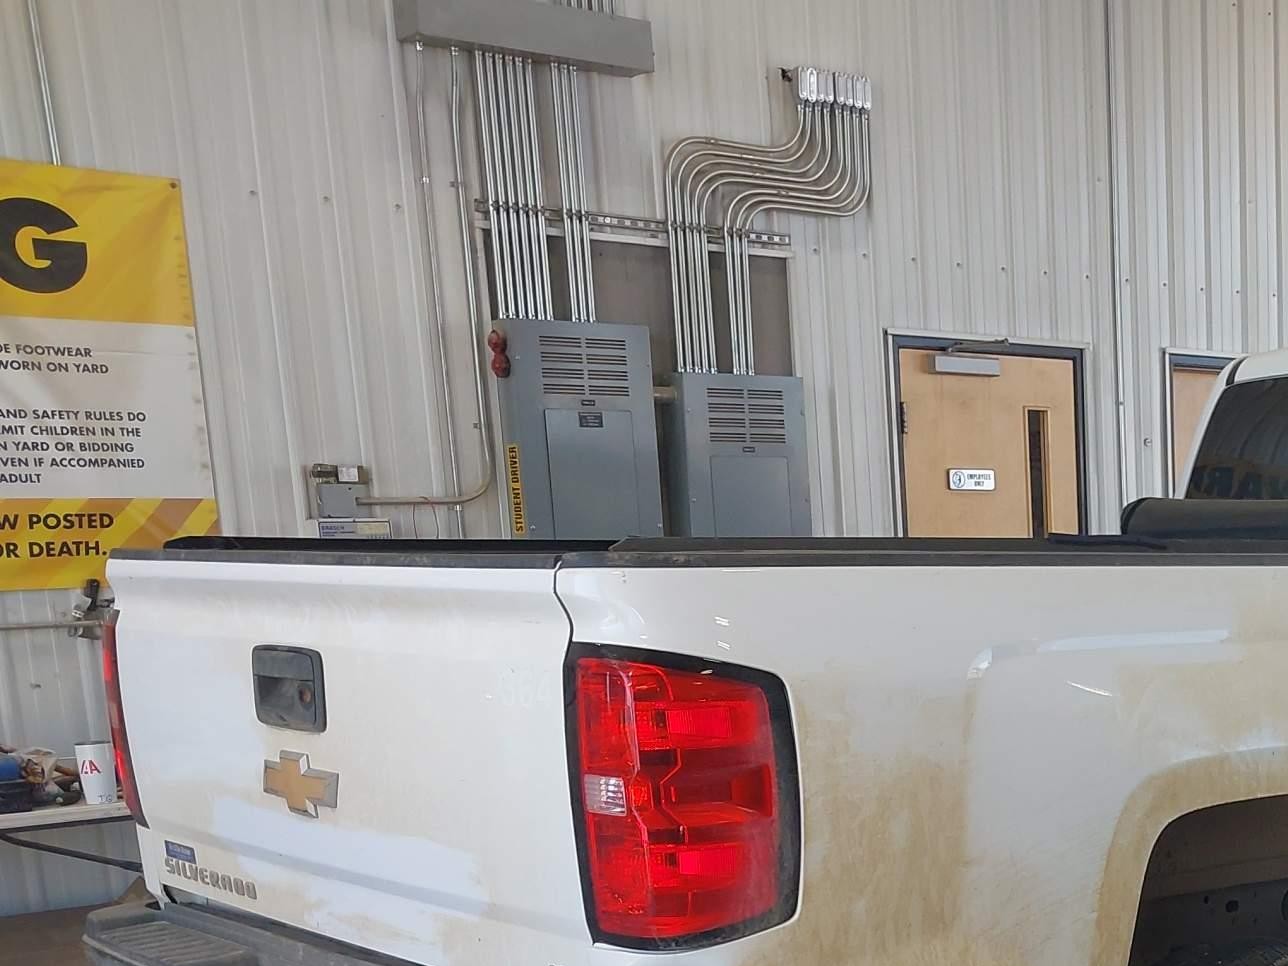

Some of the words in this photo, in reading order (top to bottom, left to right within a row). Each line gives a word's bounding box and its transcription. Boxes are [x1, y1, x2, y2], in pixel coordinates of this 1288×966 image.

[15, 344, 92, 358] FOOTWEAR
[46, 362, 69, 373] ON
[73, 363, 109, 374] YARD
[32, 409, 80, 420] SAFETY
[85, 411, 124, 421] RULES
[127, 412, 146, 422] DO
[30, 425, 96, 436] CHILDREN
[100, 427, 115, 437] IN
[119, 427, 142, 437] THE
[12, 441, 50, 452] YARD
[54, 442, 75, 452] OR
[79, 442, 134, 453] BIDDING
[33, 457, 45, 467] IF
[50, 457, 145, 469] ACCOMPANIED
[508, 446, 520, 484] DRIVER
[0, 473, 42, 484] ADULT
[511, 486, 524, 533] STUDENT
[28, 512, 114, 530] POSTED
[28, 541, 108, 558] DEATH.
[164, 856, 257, 900] SILVERADO
